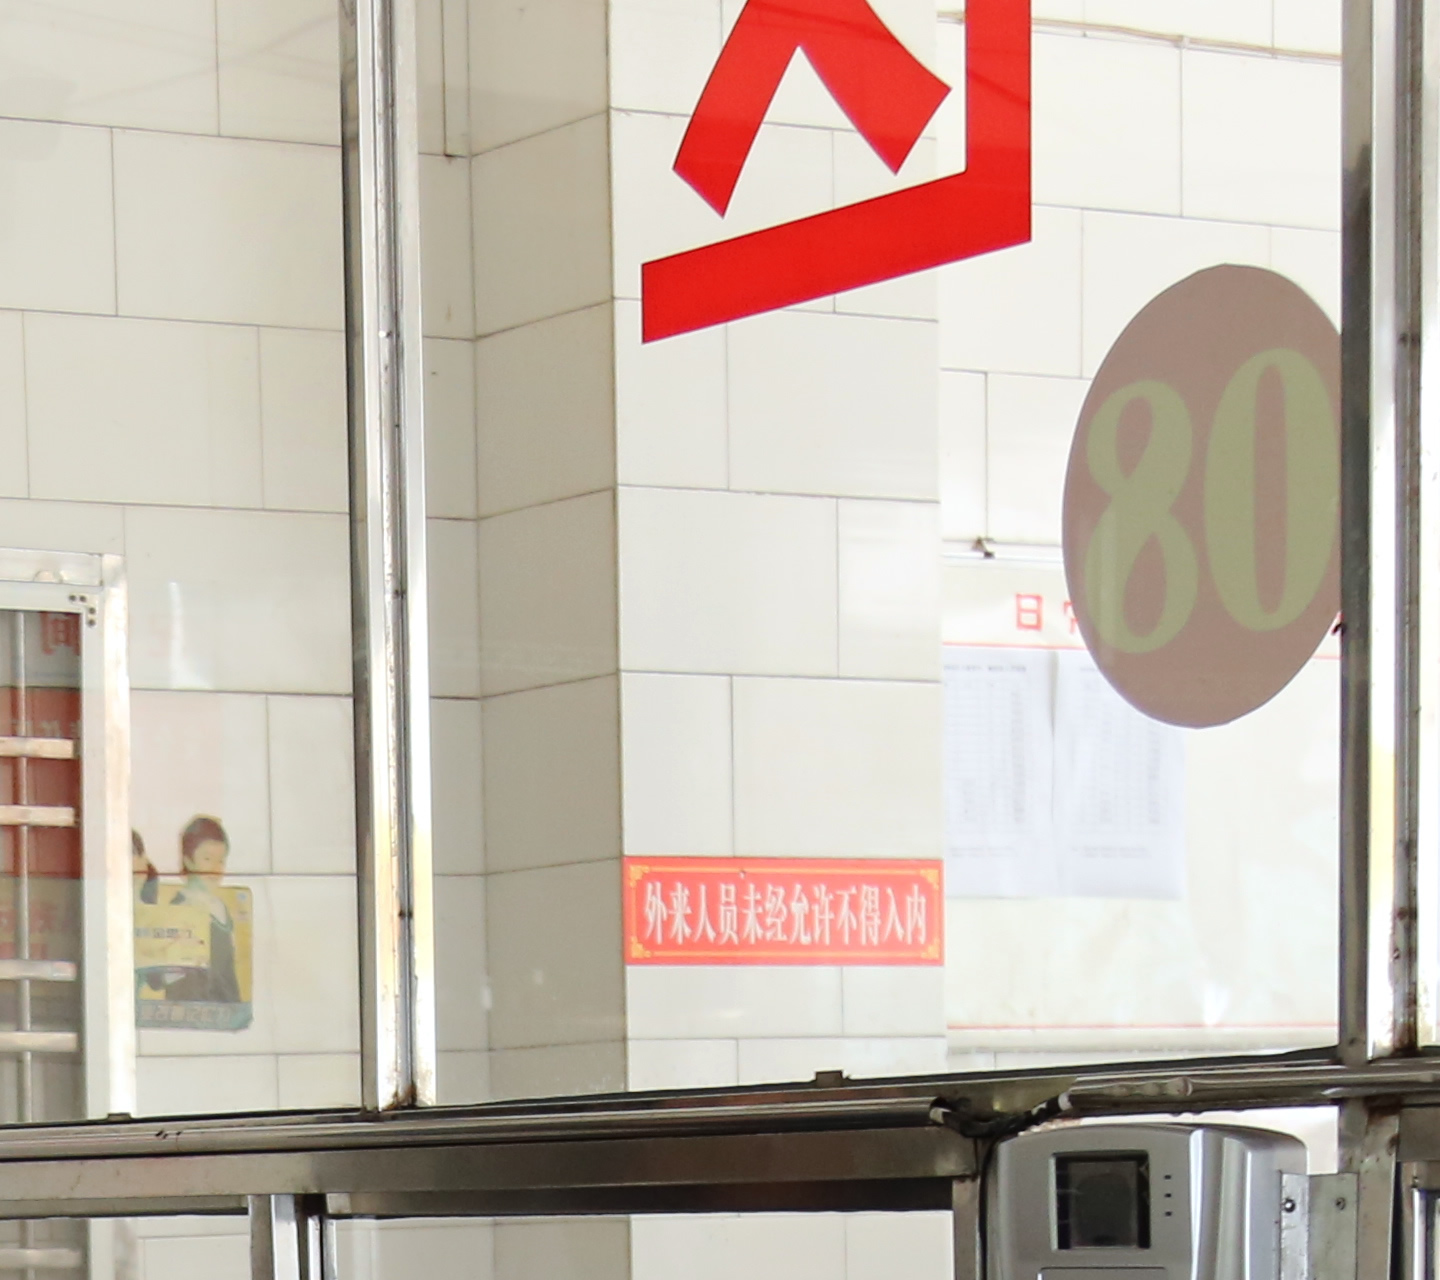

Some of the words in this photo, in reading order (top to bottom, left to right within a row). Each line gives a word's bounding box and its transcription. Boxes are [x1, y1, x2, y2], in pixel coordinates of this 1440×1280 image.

[643, 880, 928, 946] 外来人员未经允许不得入内
